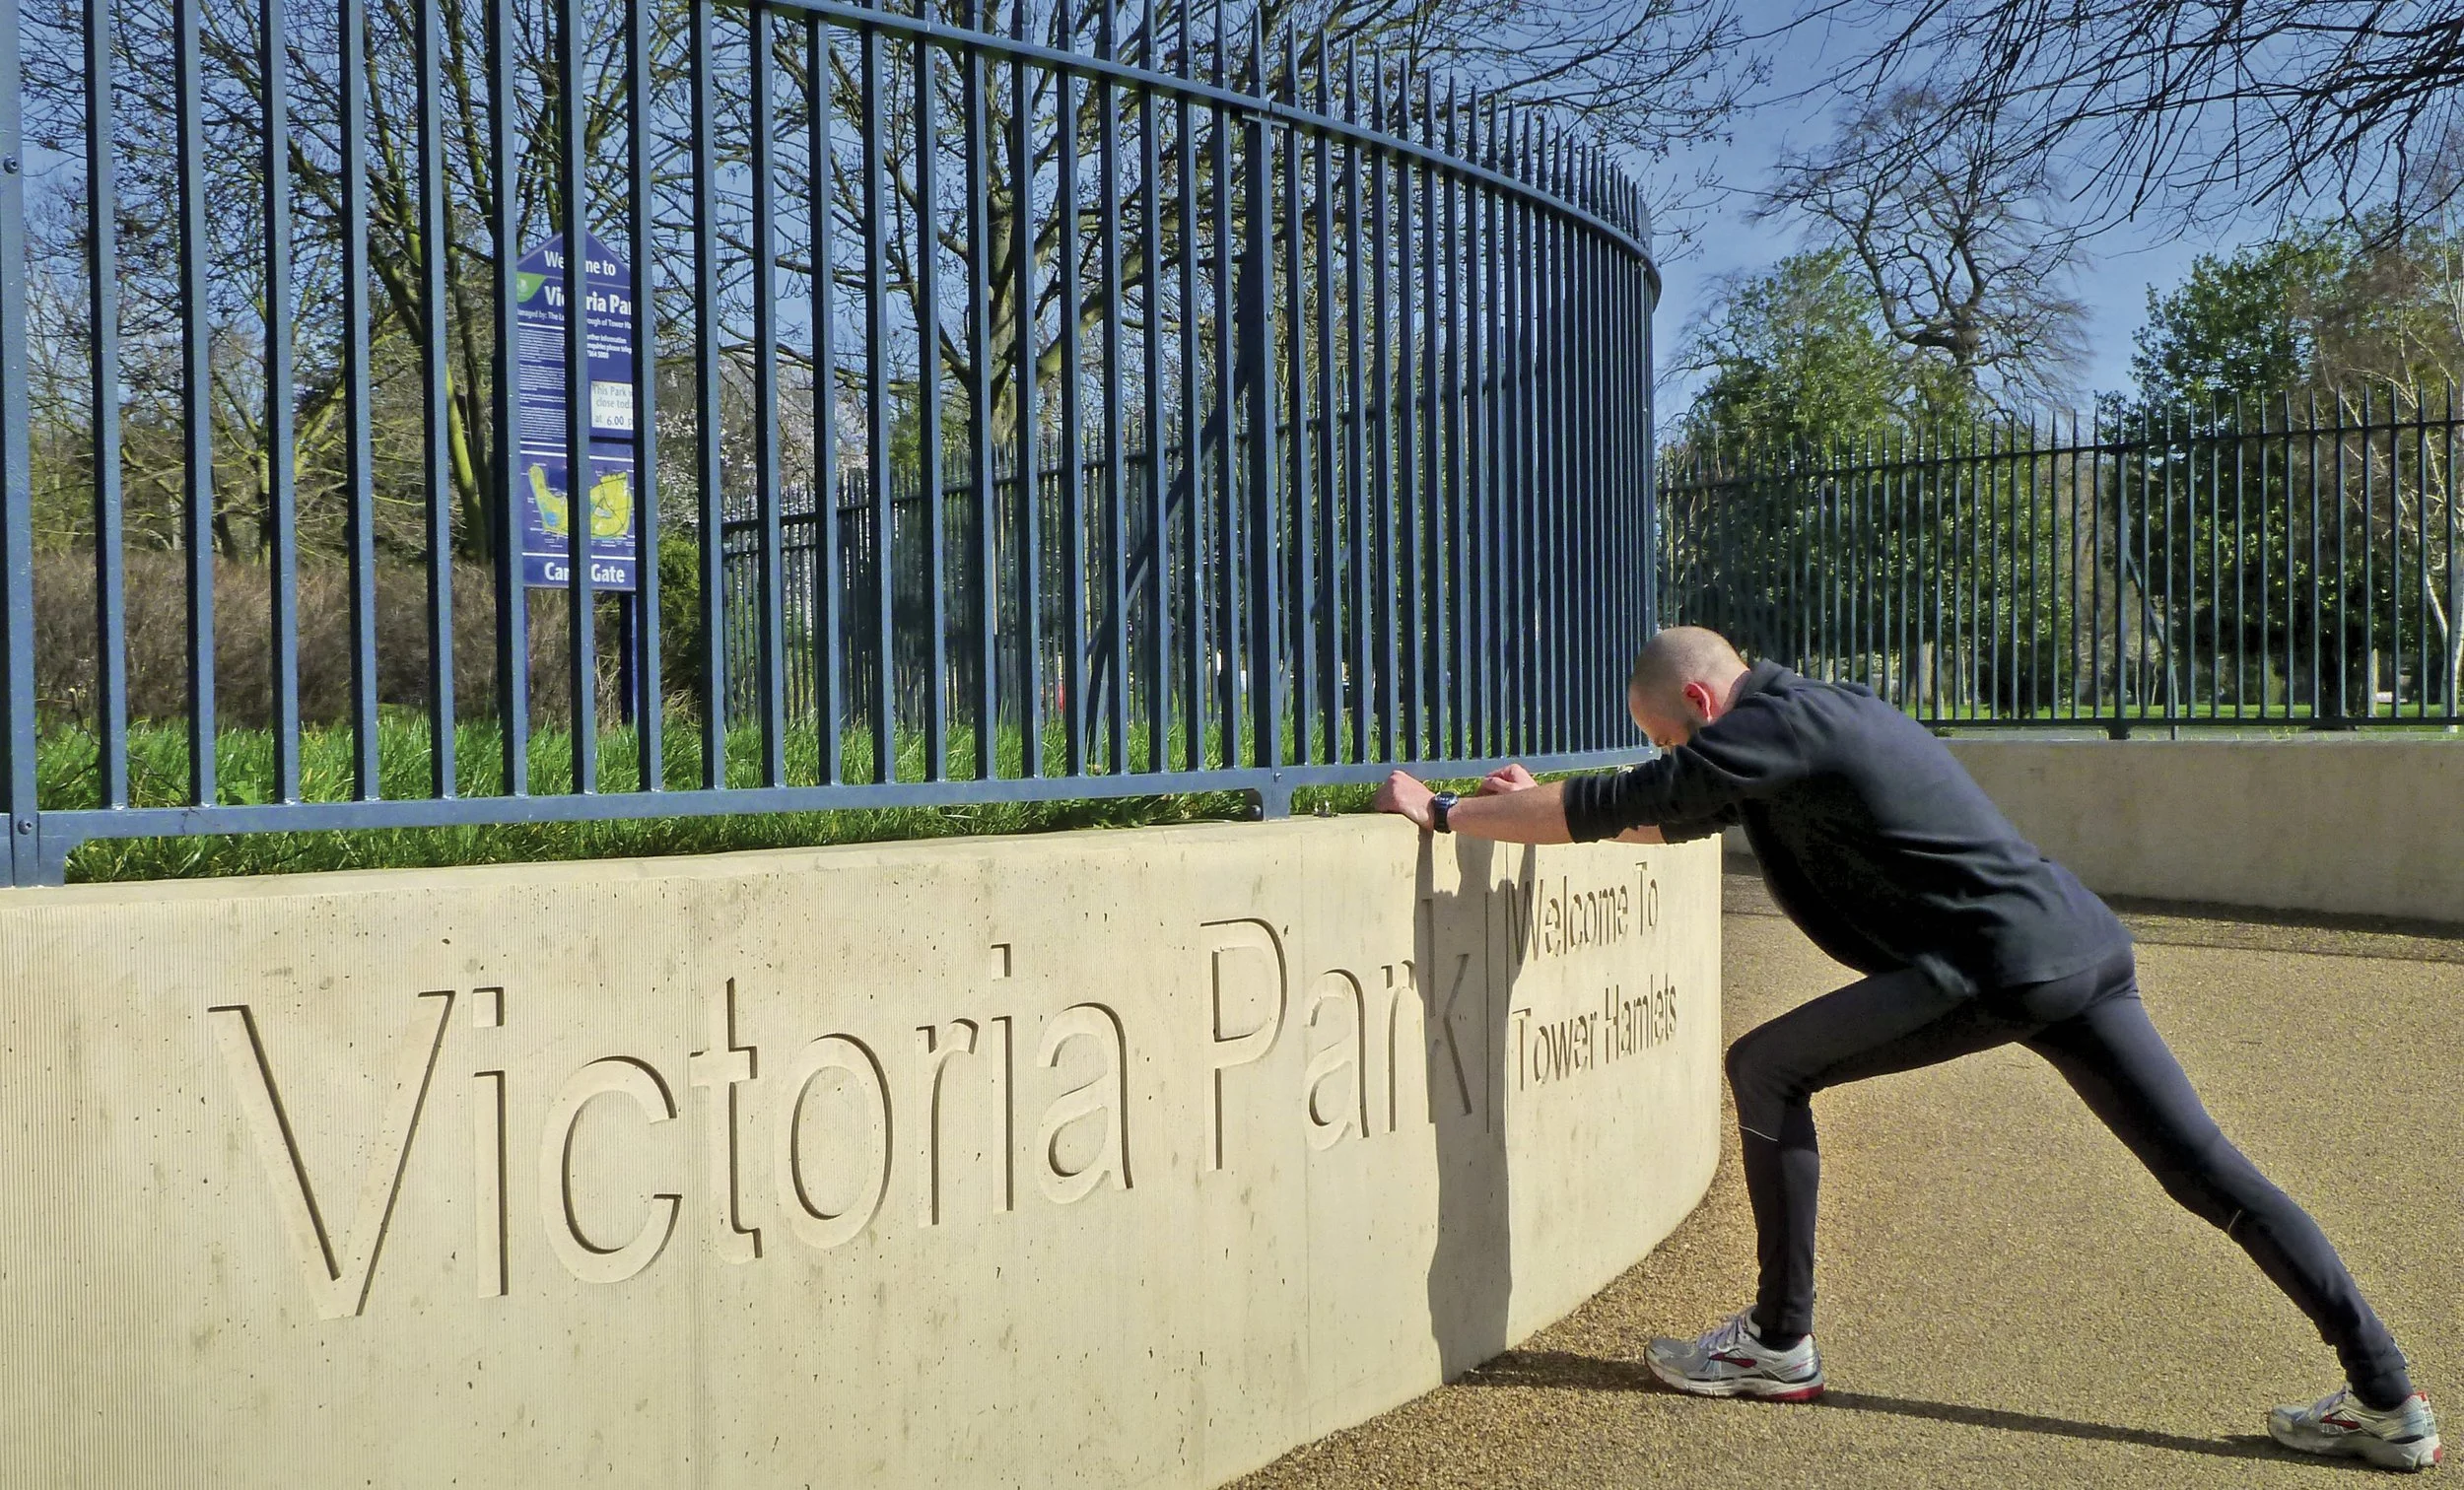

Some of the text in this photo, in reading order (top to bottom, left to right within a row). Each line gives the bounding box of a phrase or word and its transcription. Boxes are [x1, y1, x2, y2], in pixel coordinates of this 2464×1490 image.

[544, 250, 616, 276] Weme to
[544, 286, 632, 315] Viria Pa
[592, 384, 608, 395] This
[610, 386, 627, 396] Park
[596, 397, 632, 409] close tod
[595, 414, 602, 424] at
[606, 415, 624, 426] 6.00
[590, 563, 626, 583] Gate
[1510, 861, 1659, 967] Welcome To
[1512, 973, 1677, 1091] Tower Hamlets
[207, 898, 1472, 1321] Victoria Park
